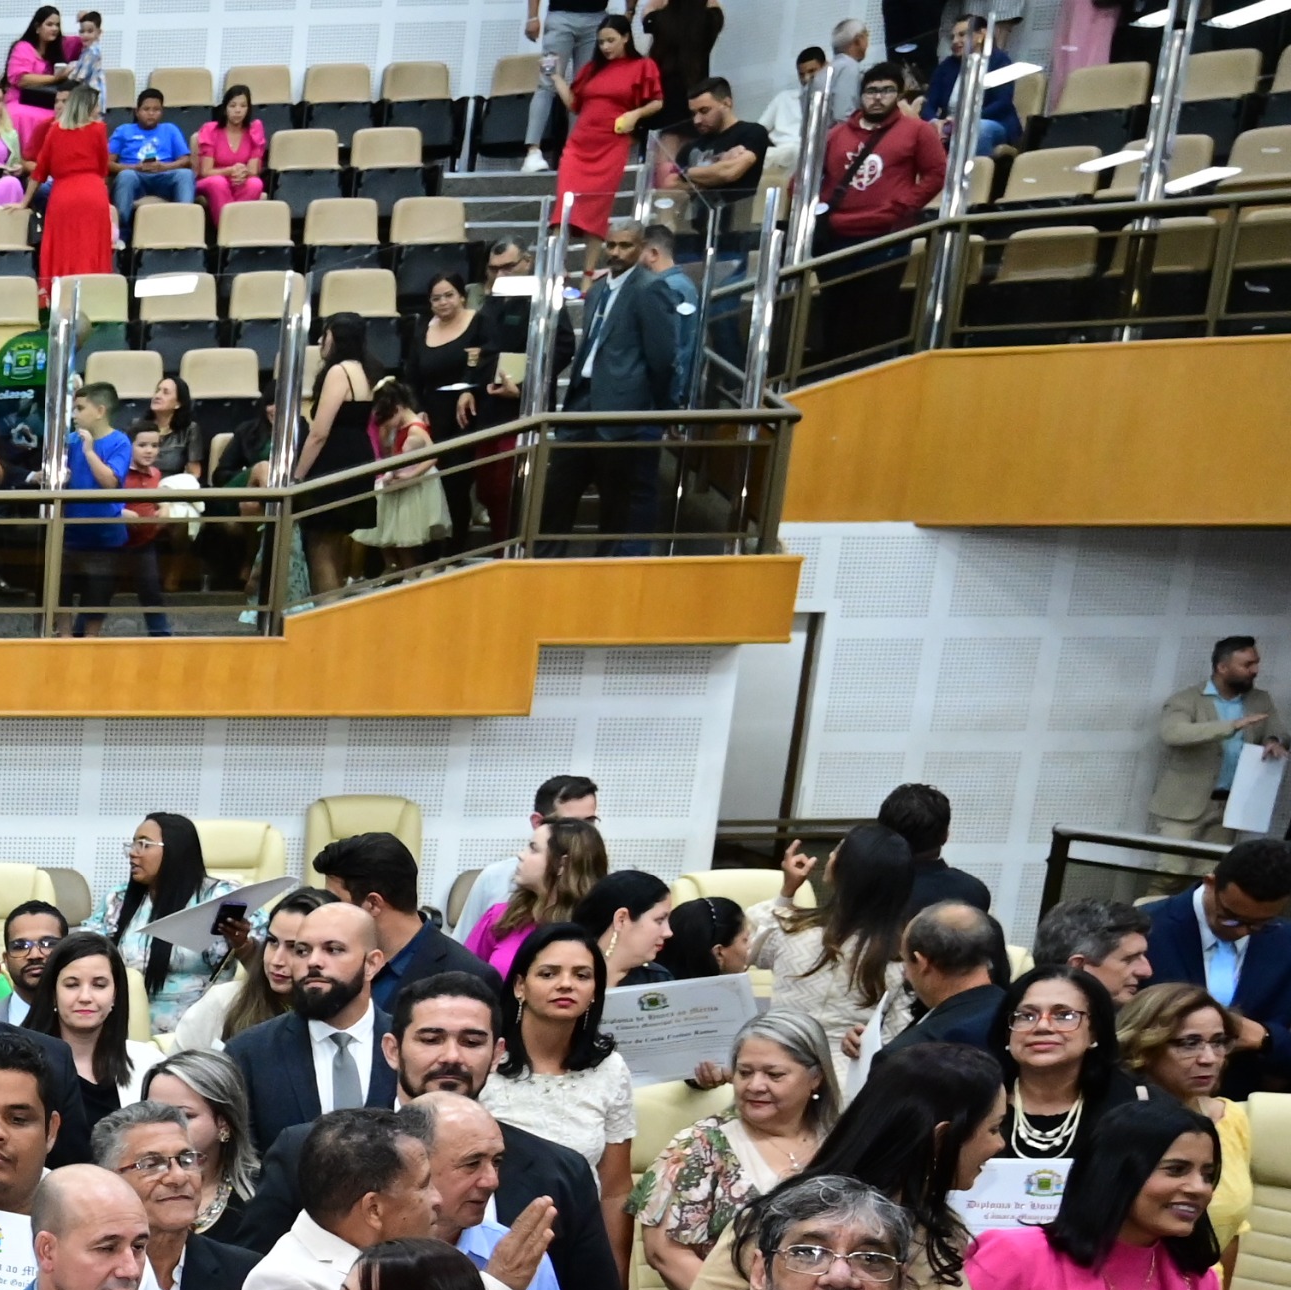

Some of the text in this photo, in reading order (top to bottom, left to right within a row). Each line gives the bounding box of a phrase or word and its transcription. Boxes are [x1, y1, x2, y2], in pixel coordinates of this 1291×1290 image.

[964, 1199, 1025, 1209] Diploma de
[5, 1264, 18, 1273] ao
